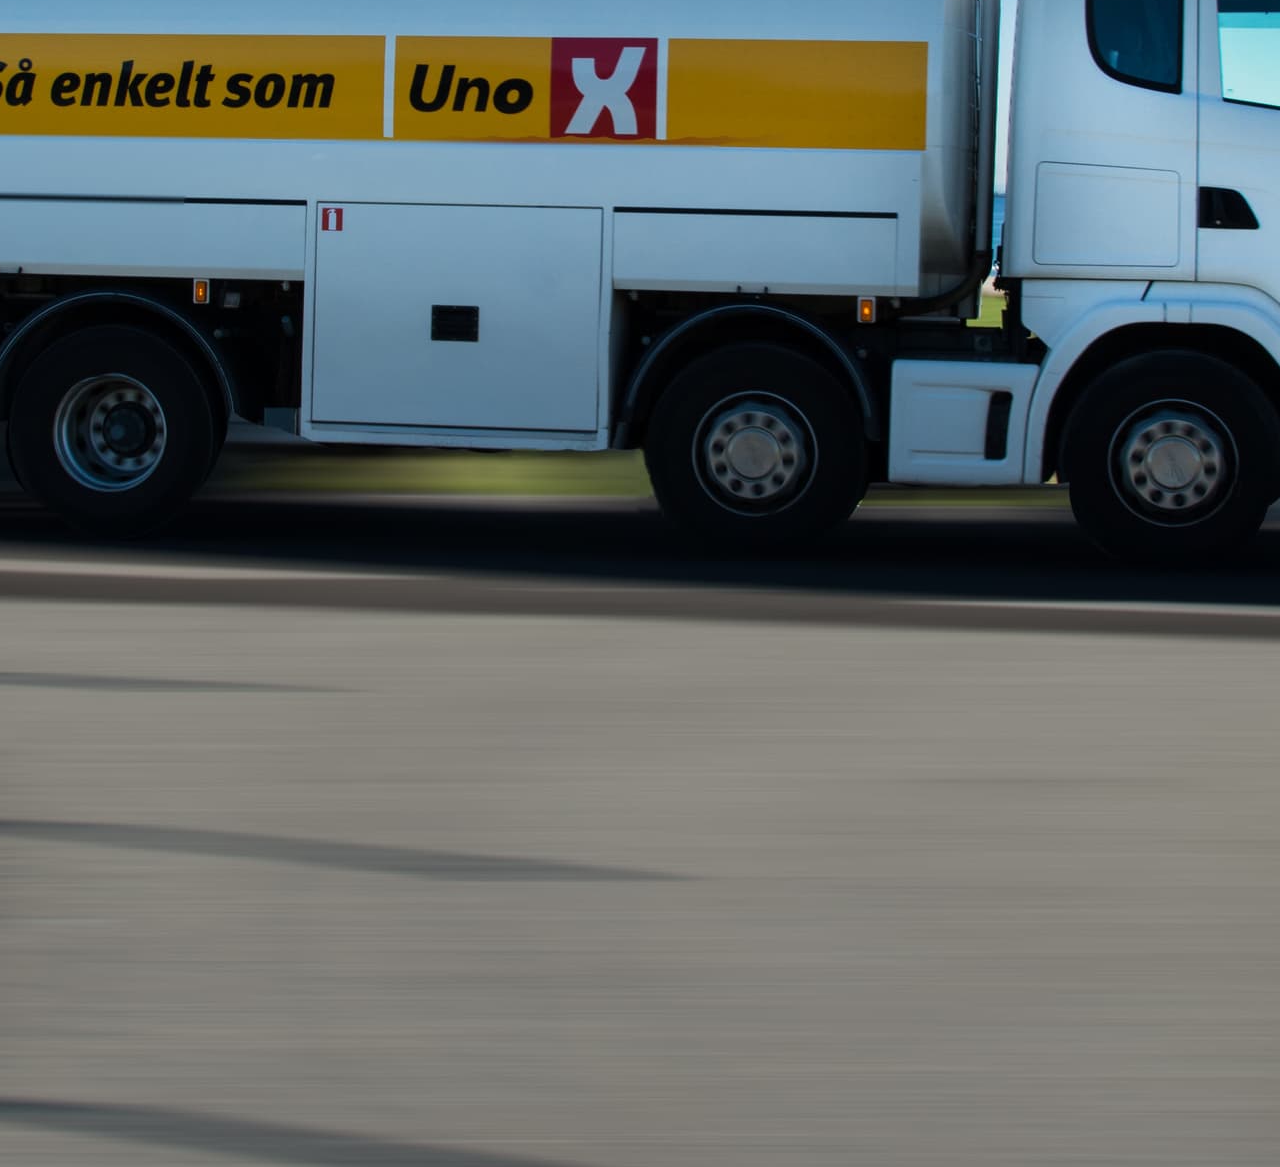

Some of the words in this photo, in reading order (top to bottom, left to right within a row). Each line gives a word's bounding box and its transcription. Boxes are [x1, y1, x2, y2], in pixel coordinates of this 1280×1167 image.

[50, 59, 216, 108] enkelt
[221, 72, 335, 109] som
[409, 63, 534, 115] Uno
[565, 46, 646, 135] X
